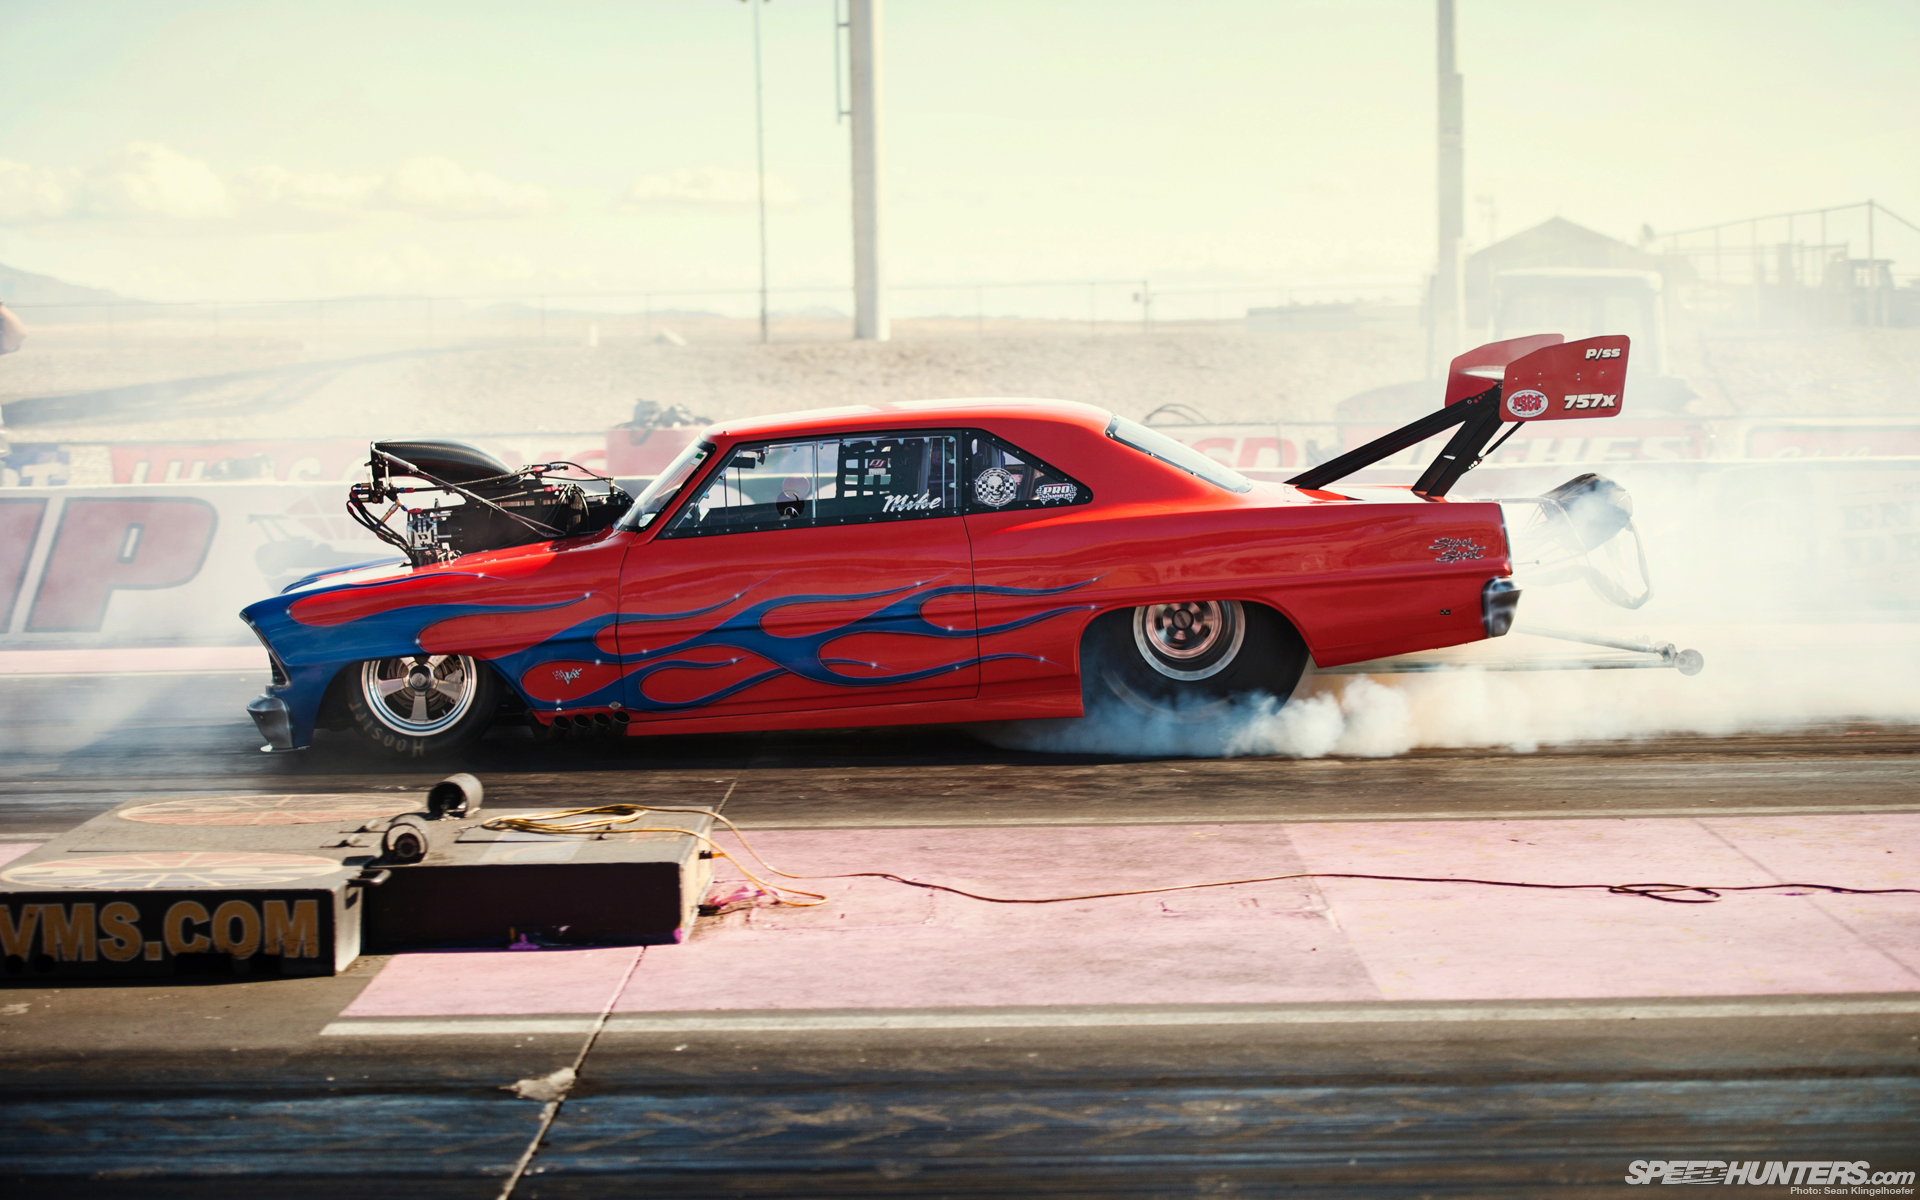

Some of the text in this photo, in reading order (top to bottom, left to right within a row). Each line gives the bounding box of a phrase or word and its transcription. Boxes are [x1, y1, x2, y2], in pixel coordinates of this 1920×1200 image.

[1513, 394, 1542, 412] PSCA
[1563, 393, 1617, 411] 757X
[1043, 485, 1070, 495] PRO
[882, 493, 942, 513] Mike
[1435, 545, 1486, 564] Sport
